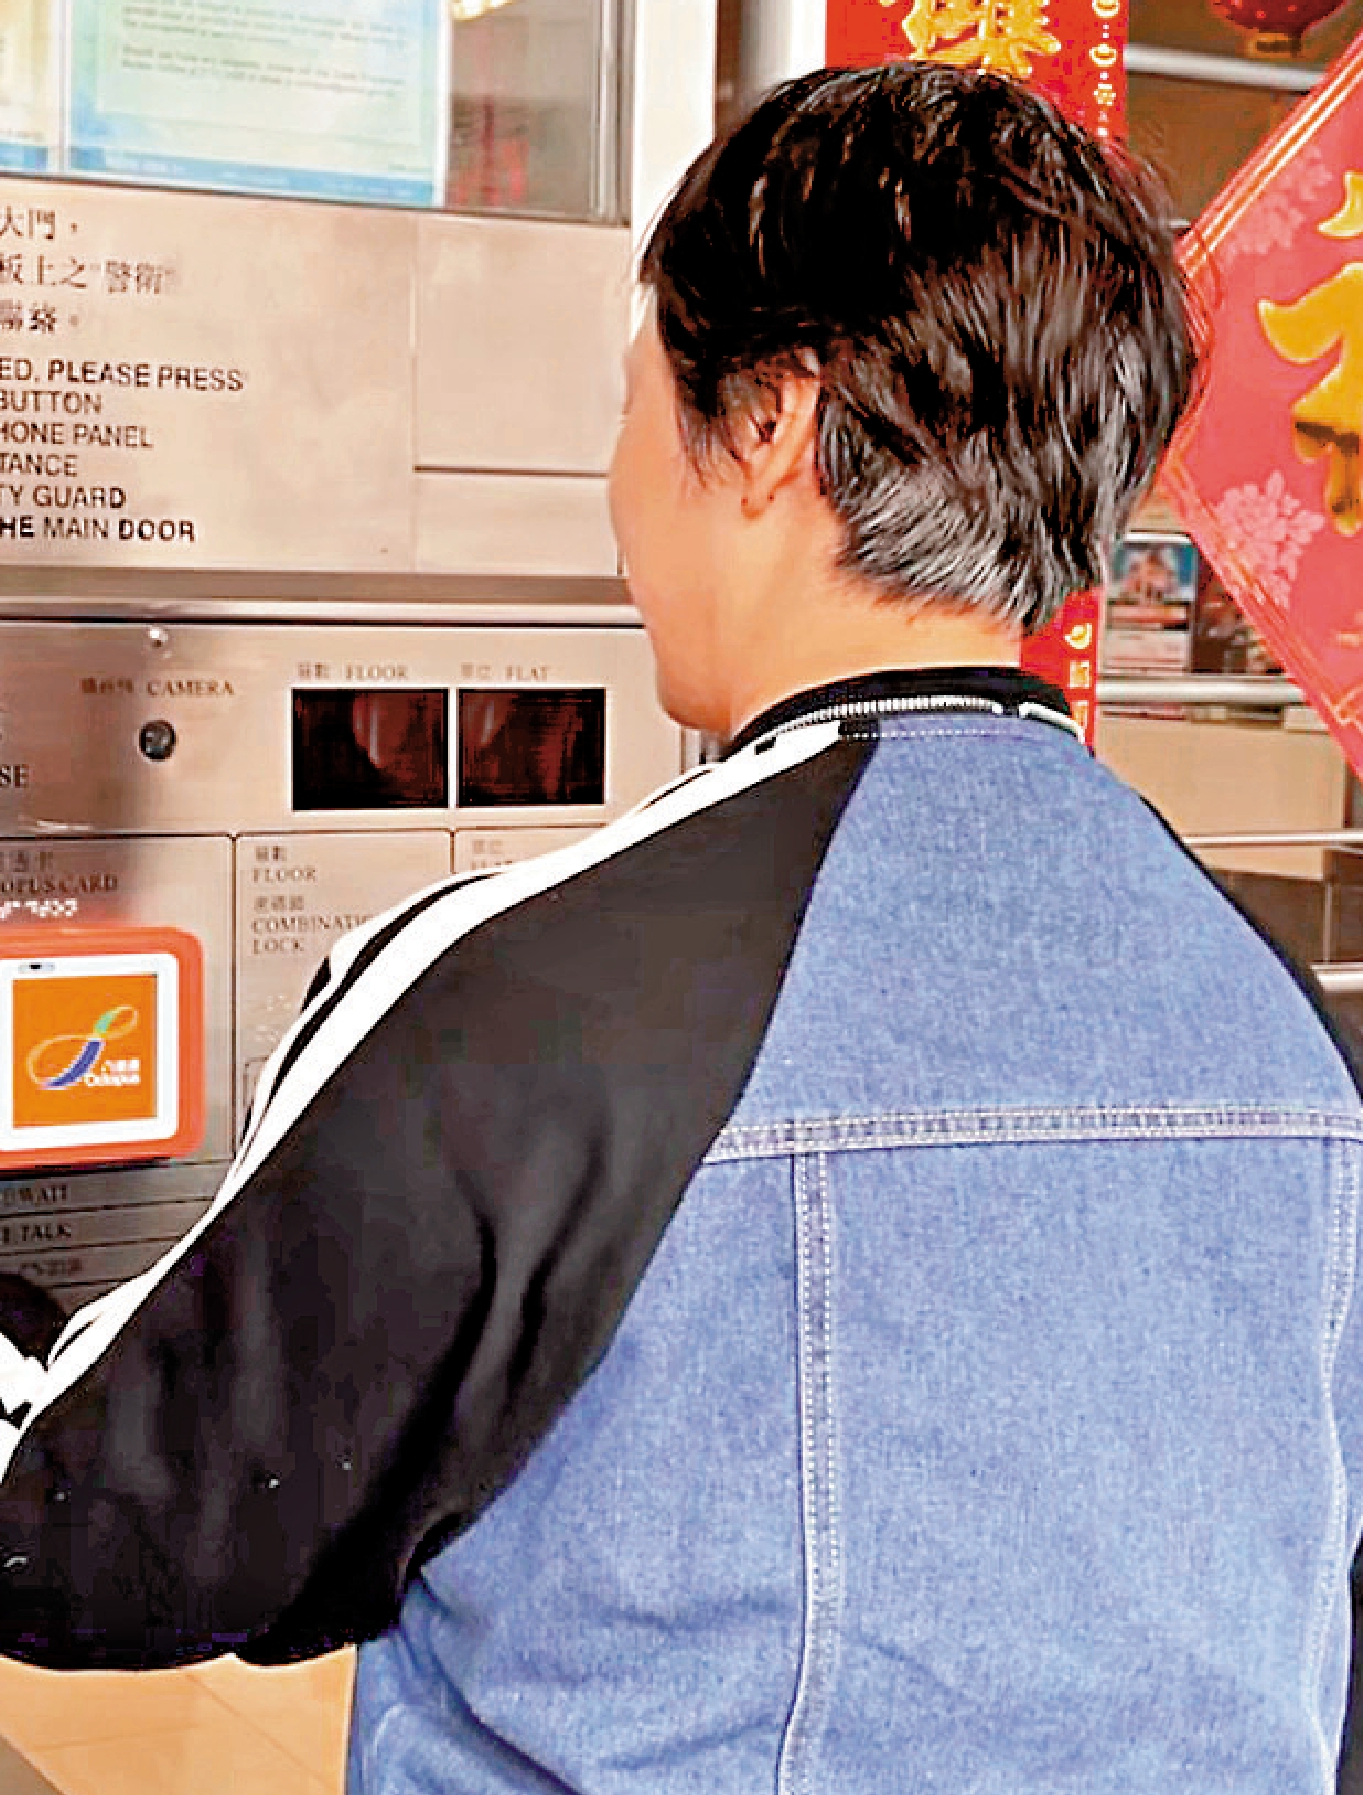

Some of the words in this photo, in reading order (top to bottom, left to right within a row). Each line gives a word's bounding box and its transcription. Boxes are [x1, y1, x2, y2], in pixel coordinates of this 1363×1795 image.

[47, 358, 151, 388] PLEASE
[156, 363, 245, 391] PRESS
[72, 422, 155, 448] PANEL
[32, 485, 128, 509] GUARD
[43, 516, 110, 540] MAIN
[117, 518, 196, 542] DOOR
[146, 678, 236, 698] CAMERA
